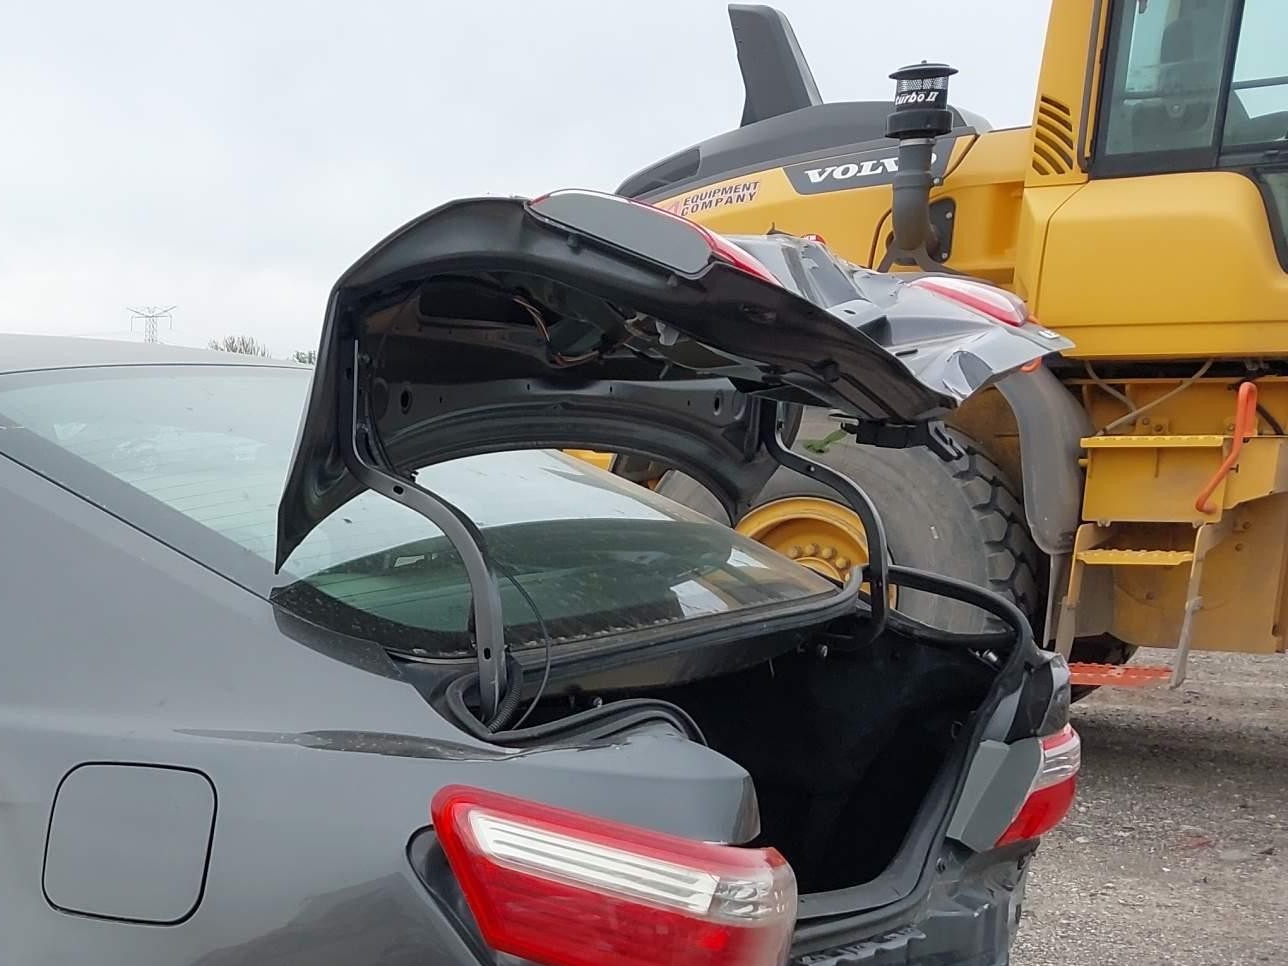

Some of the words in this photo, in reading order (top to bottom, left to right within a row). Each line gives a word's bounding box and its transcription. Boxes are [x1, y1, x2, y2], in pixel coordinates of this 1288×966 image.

[804, 152, 937, 184] VOLV
[681, 192, 757, 217] COMPANY
[683, 181, 760, 206] EQUIPMENT
